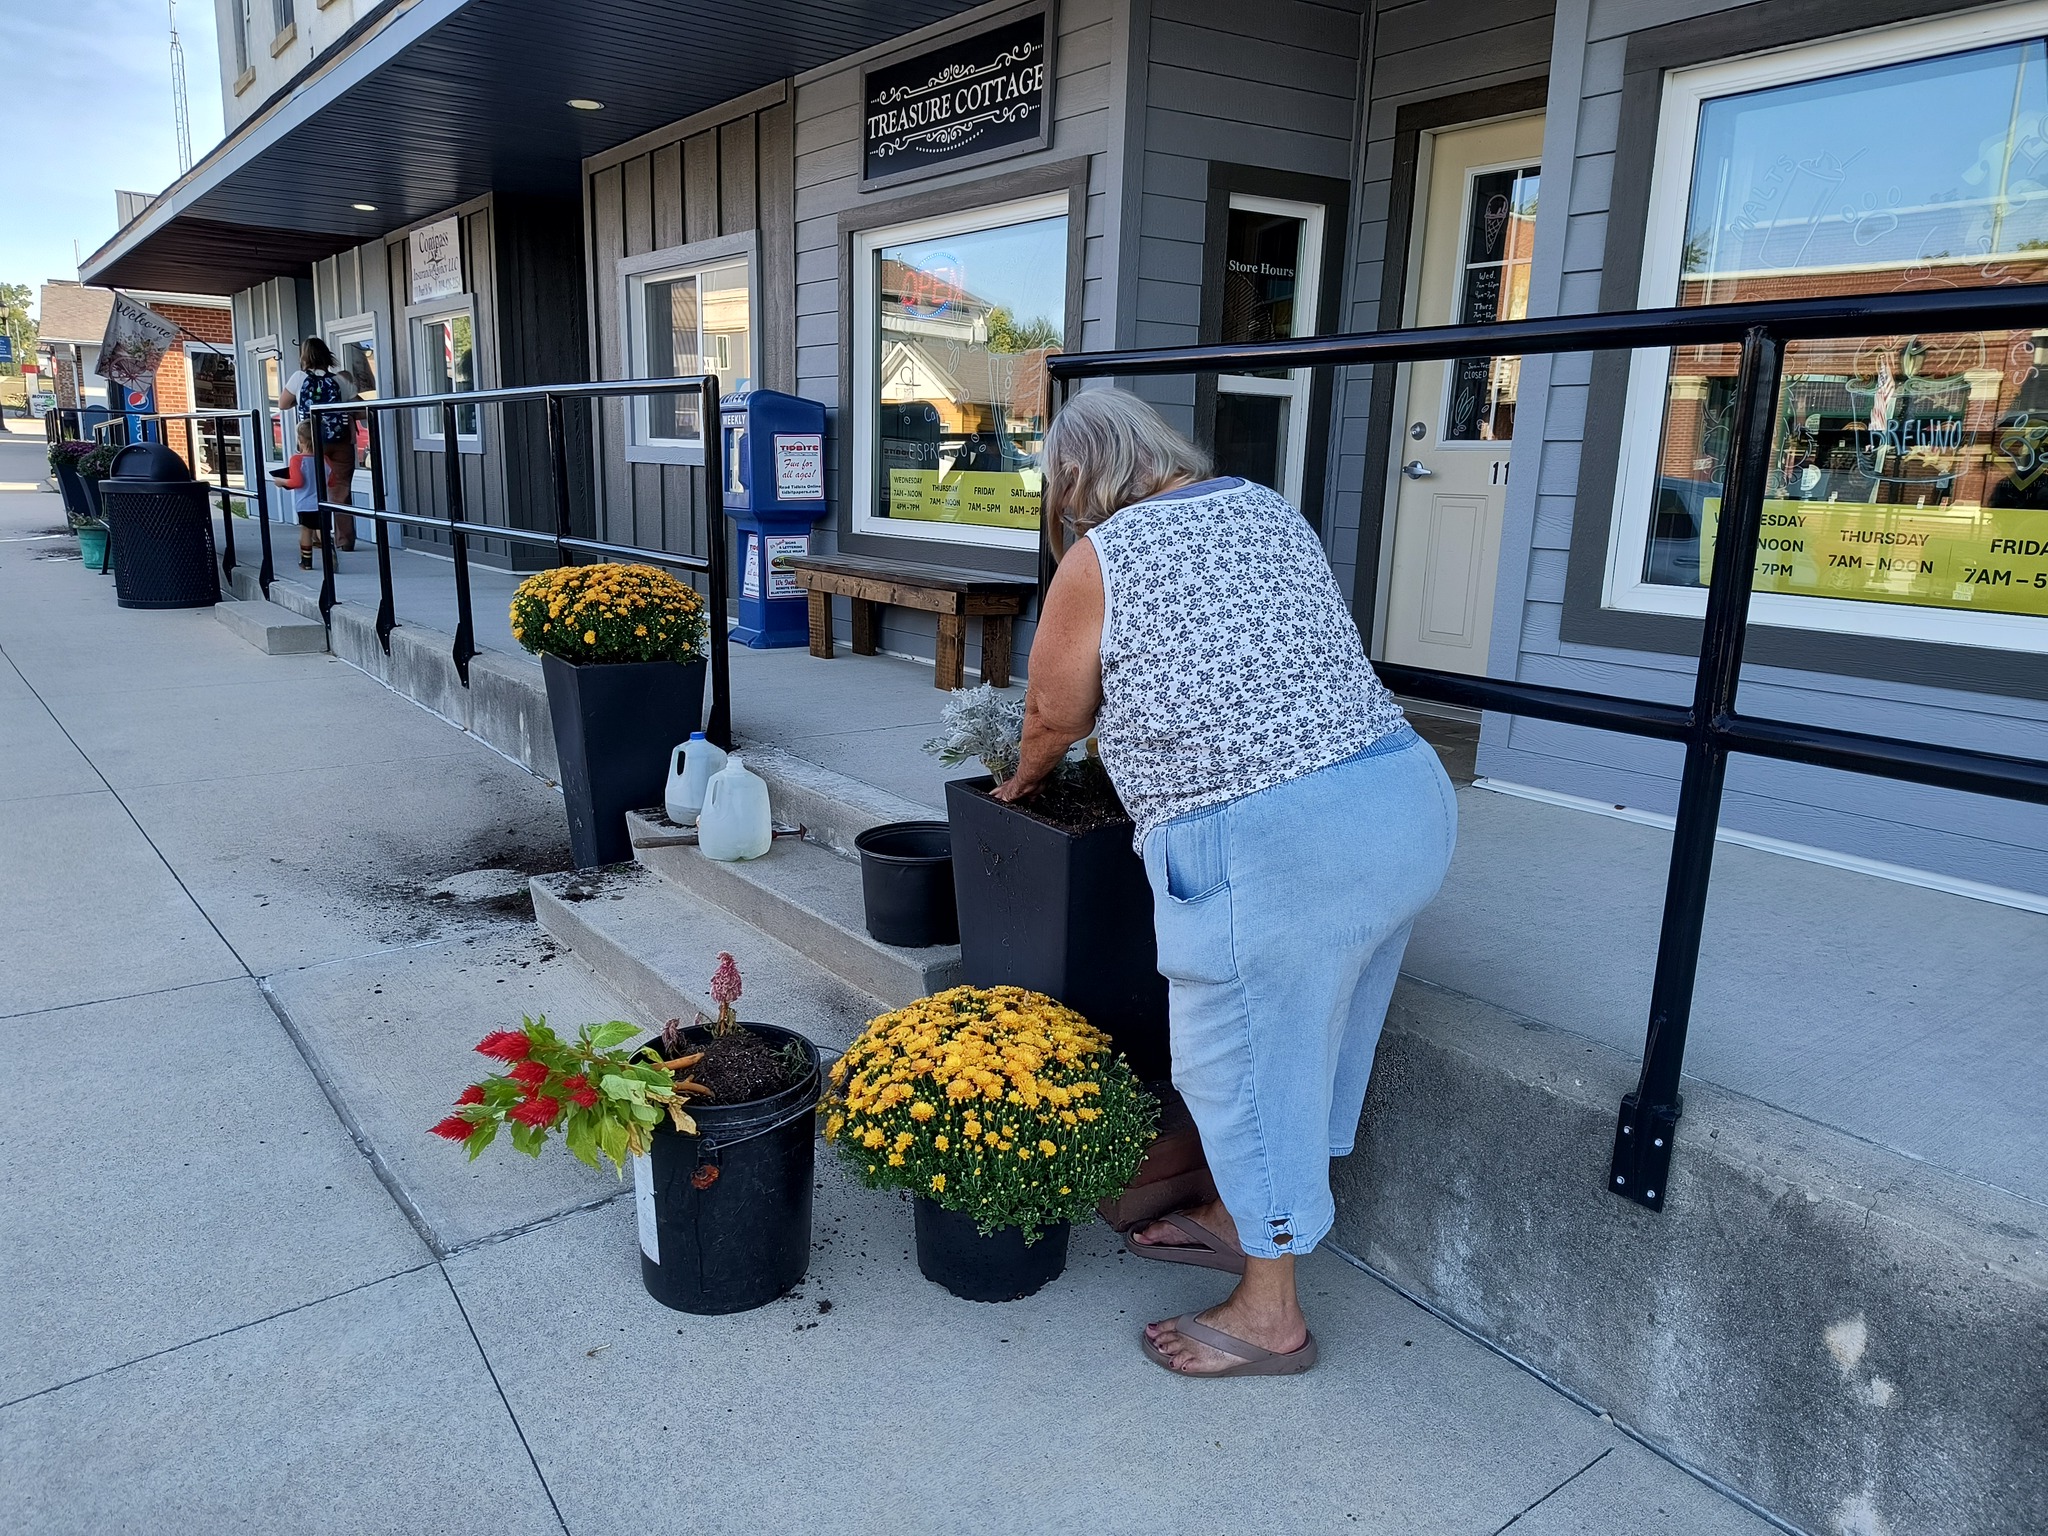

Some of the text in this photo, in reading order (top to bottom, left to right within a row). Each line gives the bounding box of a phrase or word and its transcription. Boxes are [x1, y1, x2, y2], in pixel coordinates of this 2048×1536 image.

[867, 63, 1044, 140] TREASURE COTTAGE
[1729, 153, 1794, 242] MALTS
[418, 231, 449, 254] Compass
[1228, 259, 1295, 278] Store Hours
[1478, 270, 1496, 280] Wed.
[901, 265, 966, 307] OPEN
[116, 301, 172, 340] Welcome
[1463, 370, 1488, 380] CLOSED
[722, 414, 746, 425] WEEKLY
[783, 458, 813, 470] Fun for
[782, 469, 817, 481] all ages!
[893, 476, 923, 485] WEDNESDAY
[893, 489, 904, 497] 7AM
[907, 490, 923, 498] NOON
[932, 484, 959, 493] THURSDAY
[973, 486, 996, 496] FRIDAY
[1010, 488, 1041, 499] SATURDA
[945, 498, 961, 507] NOON
[967, 502, 982, 512] 7AM
[986, 503, 1001, 513] 5PM
[1009, 505, 1025, 515] 8AM
[1030, 506, 1041, 516] 2P
[1840, 529, 1930, 547] THURSDAY
[1757, 538, 1804, 552] NOON
[1761, 563, 1793, 577] 7PM
[1828, 554, 1863, 569] 7AM
[1878, 557, 1934, 574] NOON
[1964, 568, 2012, 587] 7AM
